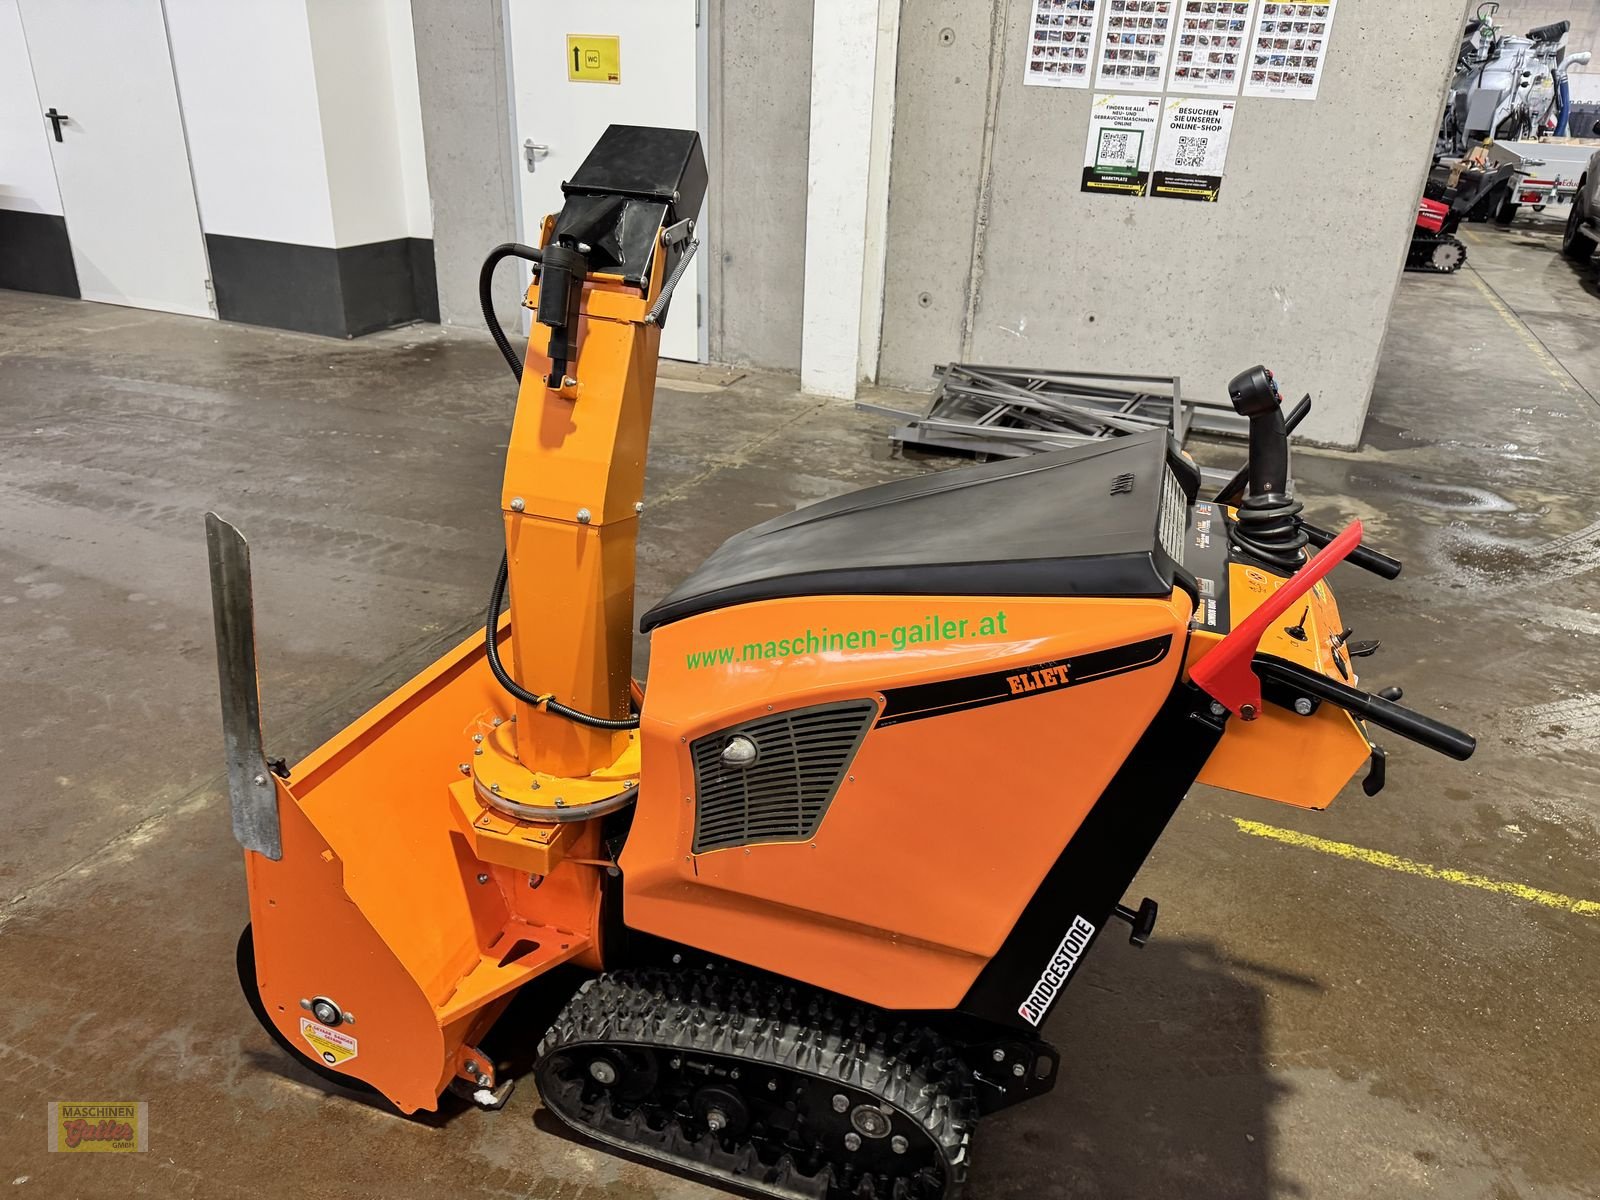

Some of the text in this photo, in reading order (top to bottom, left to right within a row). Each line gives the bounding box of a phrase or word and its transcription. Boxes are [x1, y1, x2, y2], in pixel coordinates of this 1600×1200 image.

[1178, 107, 1219, 116] BESUCHEN
[1094, 114, 1154, 123] GEBRAUCHTMASCHINEN
[1186, 116, 1221, 124] UNSEREN
[1170, 122, 1222, 132] ONLINE-SHOP
[685, 610, 1008, 670] www.maschinen-gailer.at
[1006, 664, 1070, 694] ELIET
[1022, 919, 1092, 1024] BRIDGESTONE
